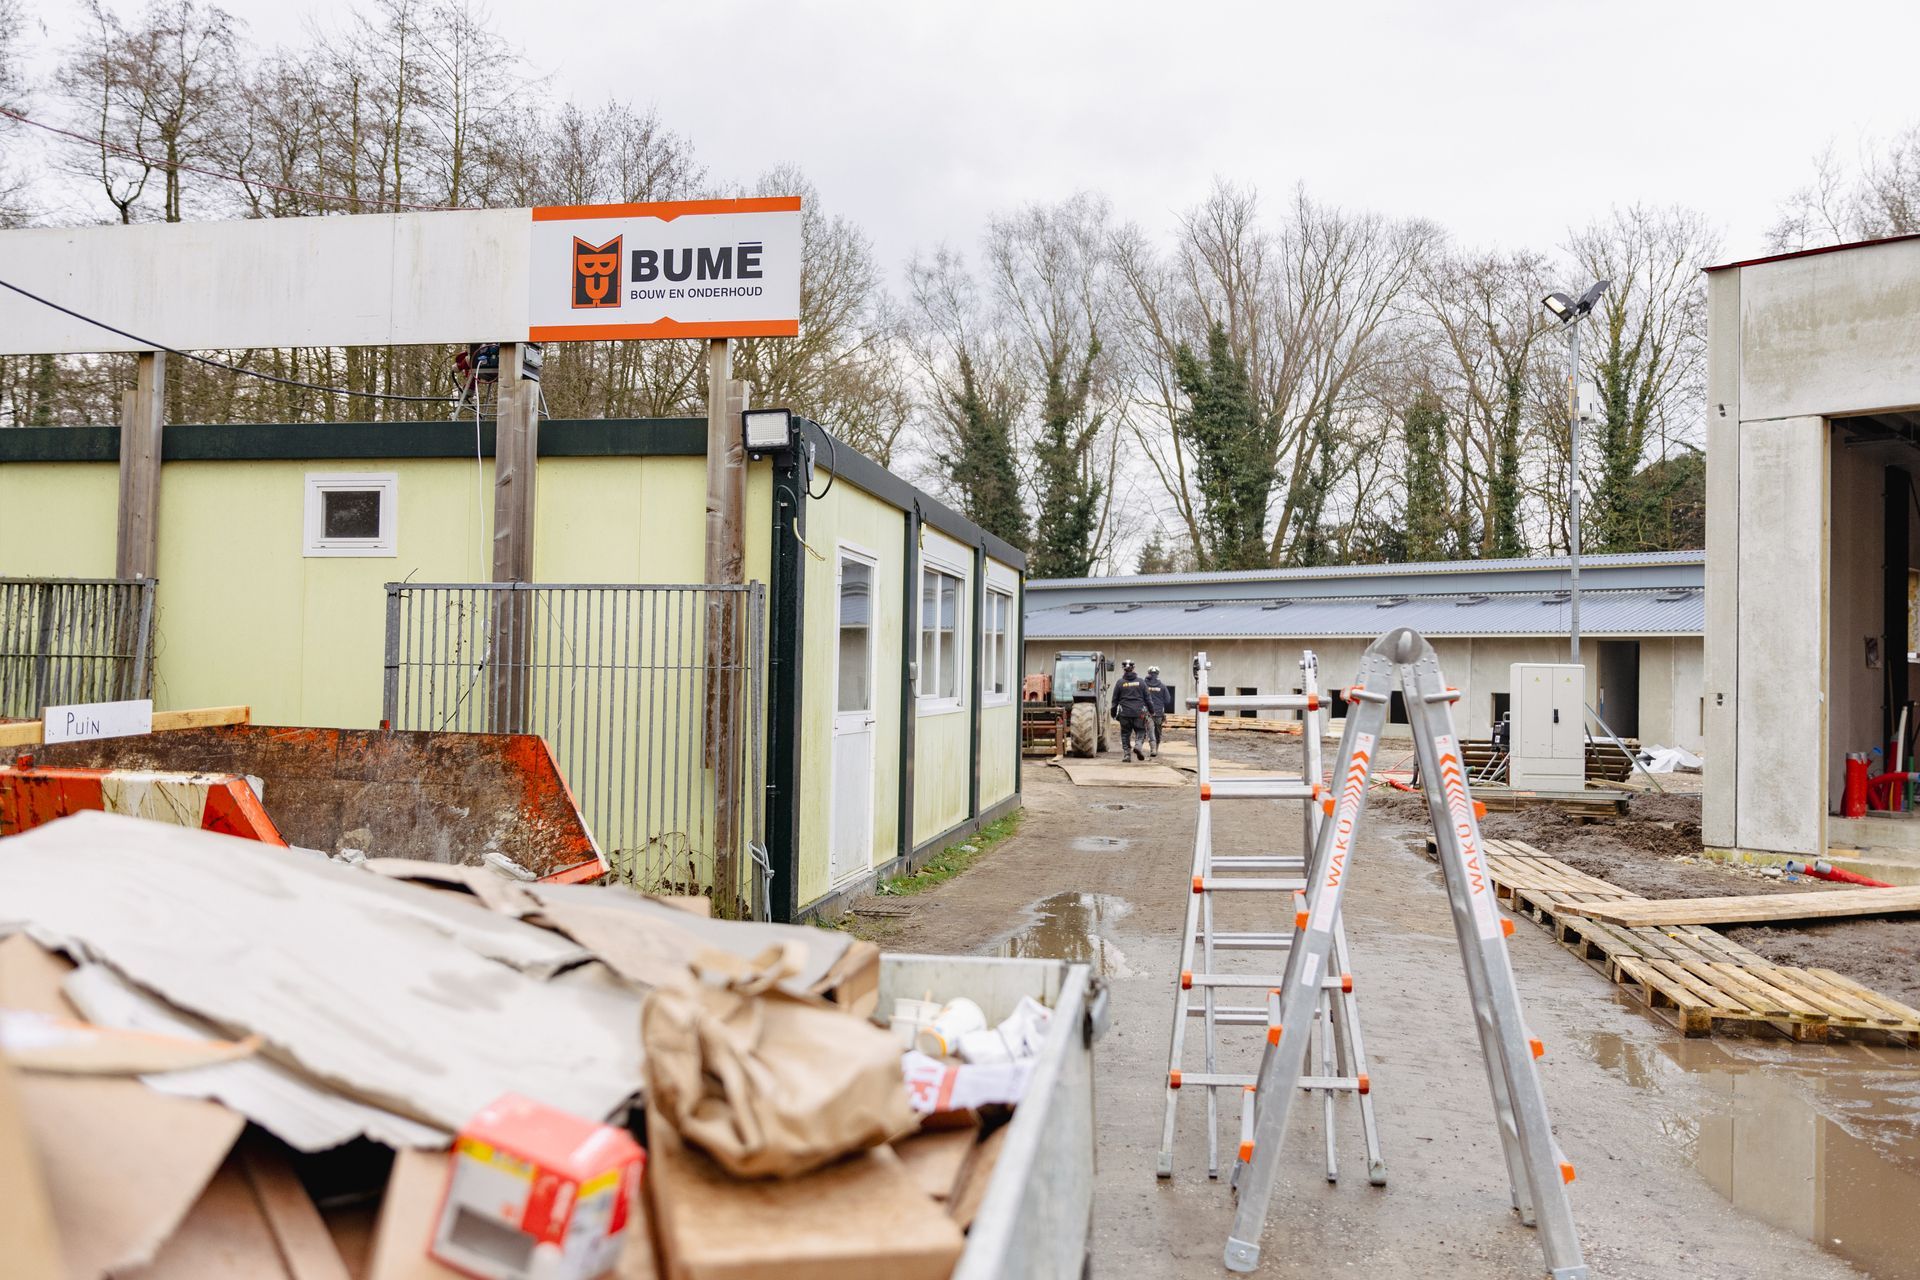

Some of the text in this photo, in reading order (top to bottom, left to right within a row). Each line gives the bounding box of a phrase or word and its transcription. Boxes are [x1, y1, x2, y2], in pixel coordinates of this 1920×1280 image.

[630, 286, 763, 300] BOUW EN ONDERHOUD
